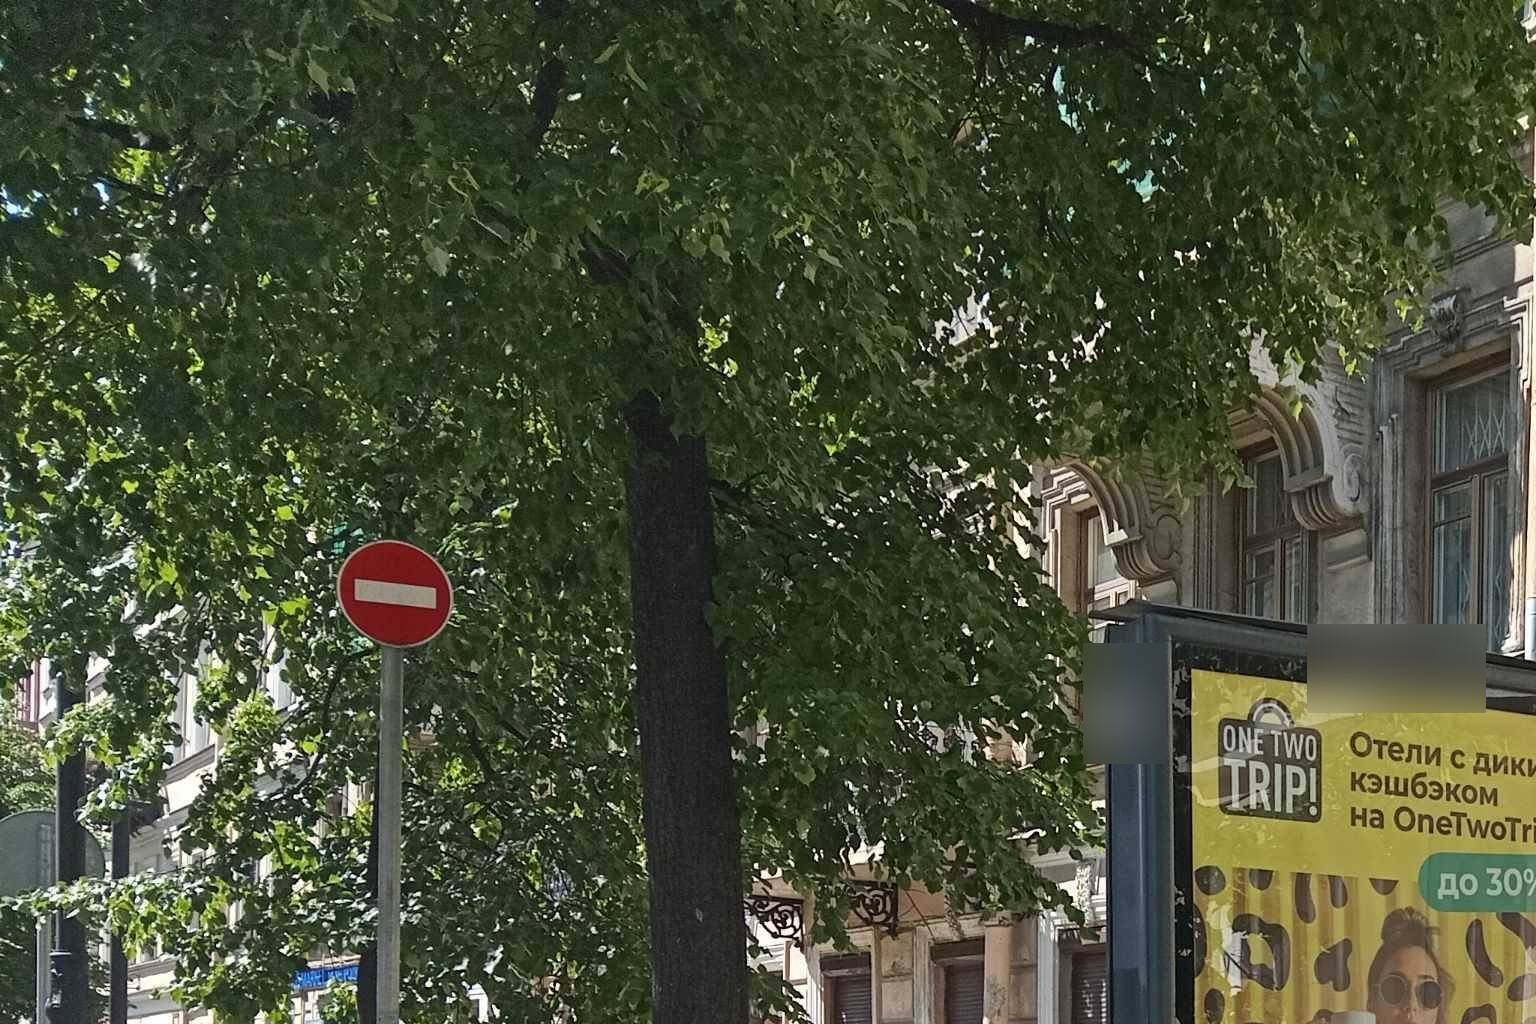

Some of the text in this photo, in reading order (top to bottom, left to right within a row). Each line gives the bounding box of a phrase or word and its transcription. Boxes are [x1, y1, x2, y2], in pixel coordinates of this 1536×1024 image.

[1223, 724, 1318, 762] ONE TWO
[1349, 731, 1443, 767] Отели
[1450, 749, 1466, 770] с
[1223, 758, 1318, 816] TRIP!
[1350, 771, 1498, 807] кэшбэком
[1350, 806, 1385, 830] на
[1437, 872, 1479, 900] до
